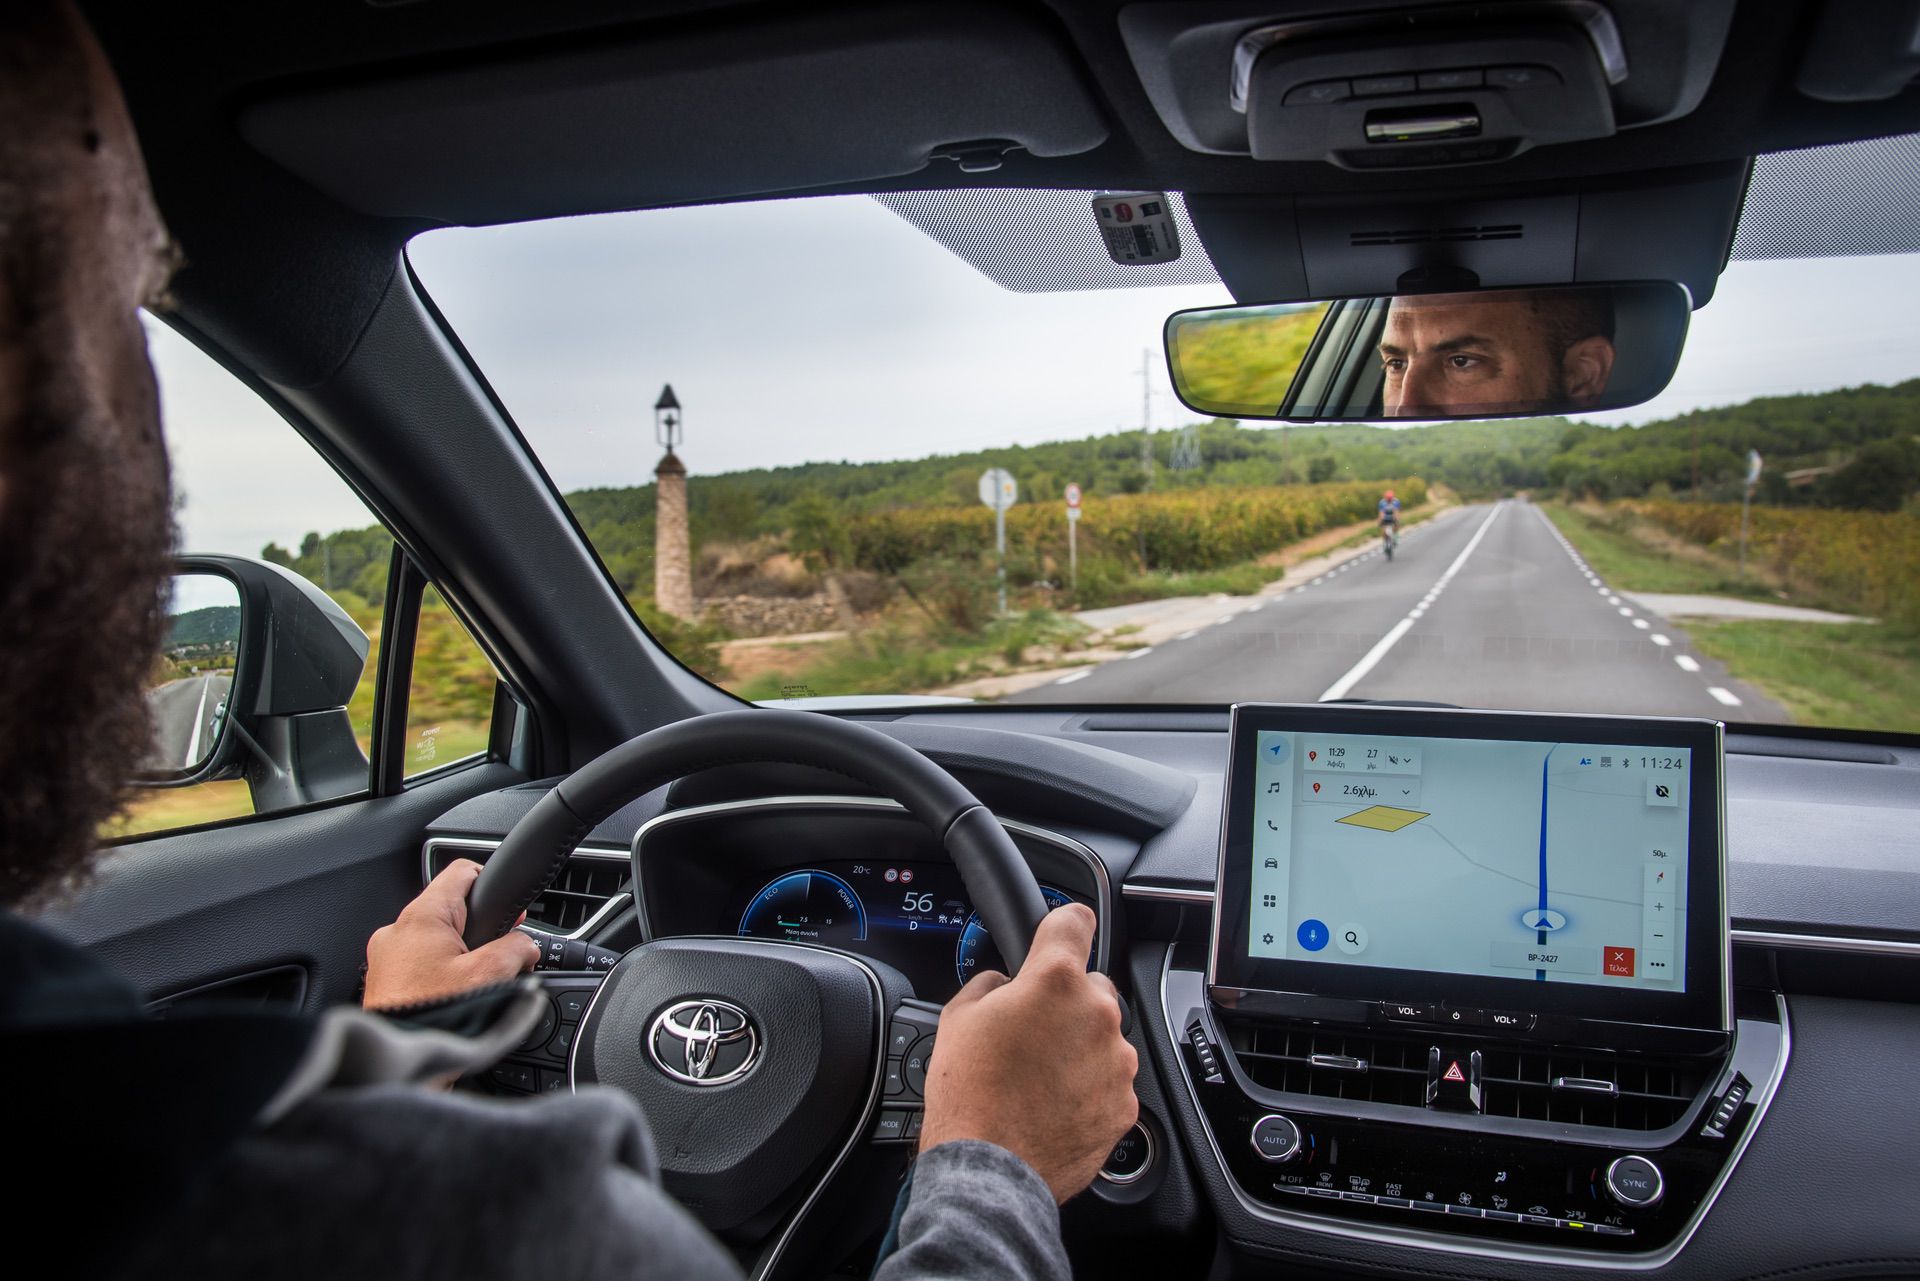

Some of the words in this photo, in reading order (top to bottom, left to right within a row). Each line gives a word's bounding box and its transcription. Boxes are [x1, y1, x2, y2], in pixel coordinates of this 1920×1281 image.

[1329, 748, 1345, 757] 11:29
[1367, 749, 1378, 758] 2.7
[1641, 757, 1683, 769] 11:24
[764, 887, 779, 900] ECO
[837, 888, 855, 910] POWER
[902, 891, 934, 913] 56
[1047, 899, 1061, 907] 140
[909, 921, 918, 931] D
[966, 939, 977, 947] 40
[1528, 953, 1558, 963] BP-2427
[964, 959, 975, 967] 20
[881, 1121, 899, 1129] MODE
[1263, 1135, 1287, 1146] AUTO
[1287, 1175, 1303, 1184] OFF
[1622, 1179, 1648, 1189] SYNC
[1316, 1180, 1334, 1189] FRONT
[1352, 1185, 1366, 1193] REAR
[1386, 1182, 1402, 1190] FAST
[1386, 1189, 1401, 1197] ECO
[1604, 1215, 1623, 1225] A/C
